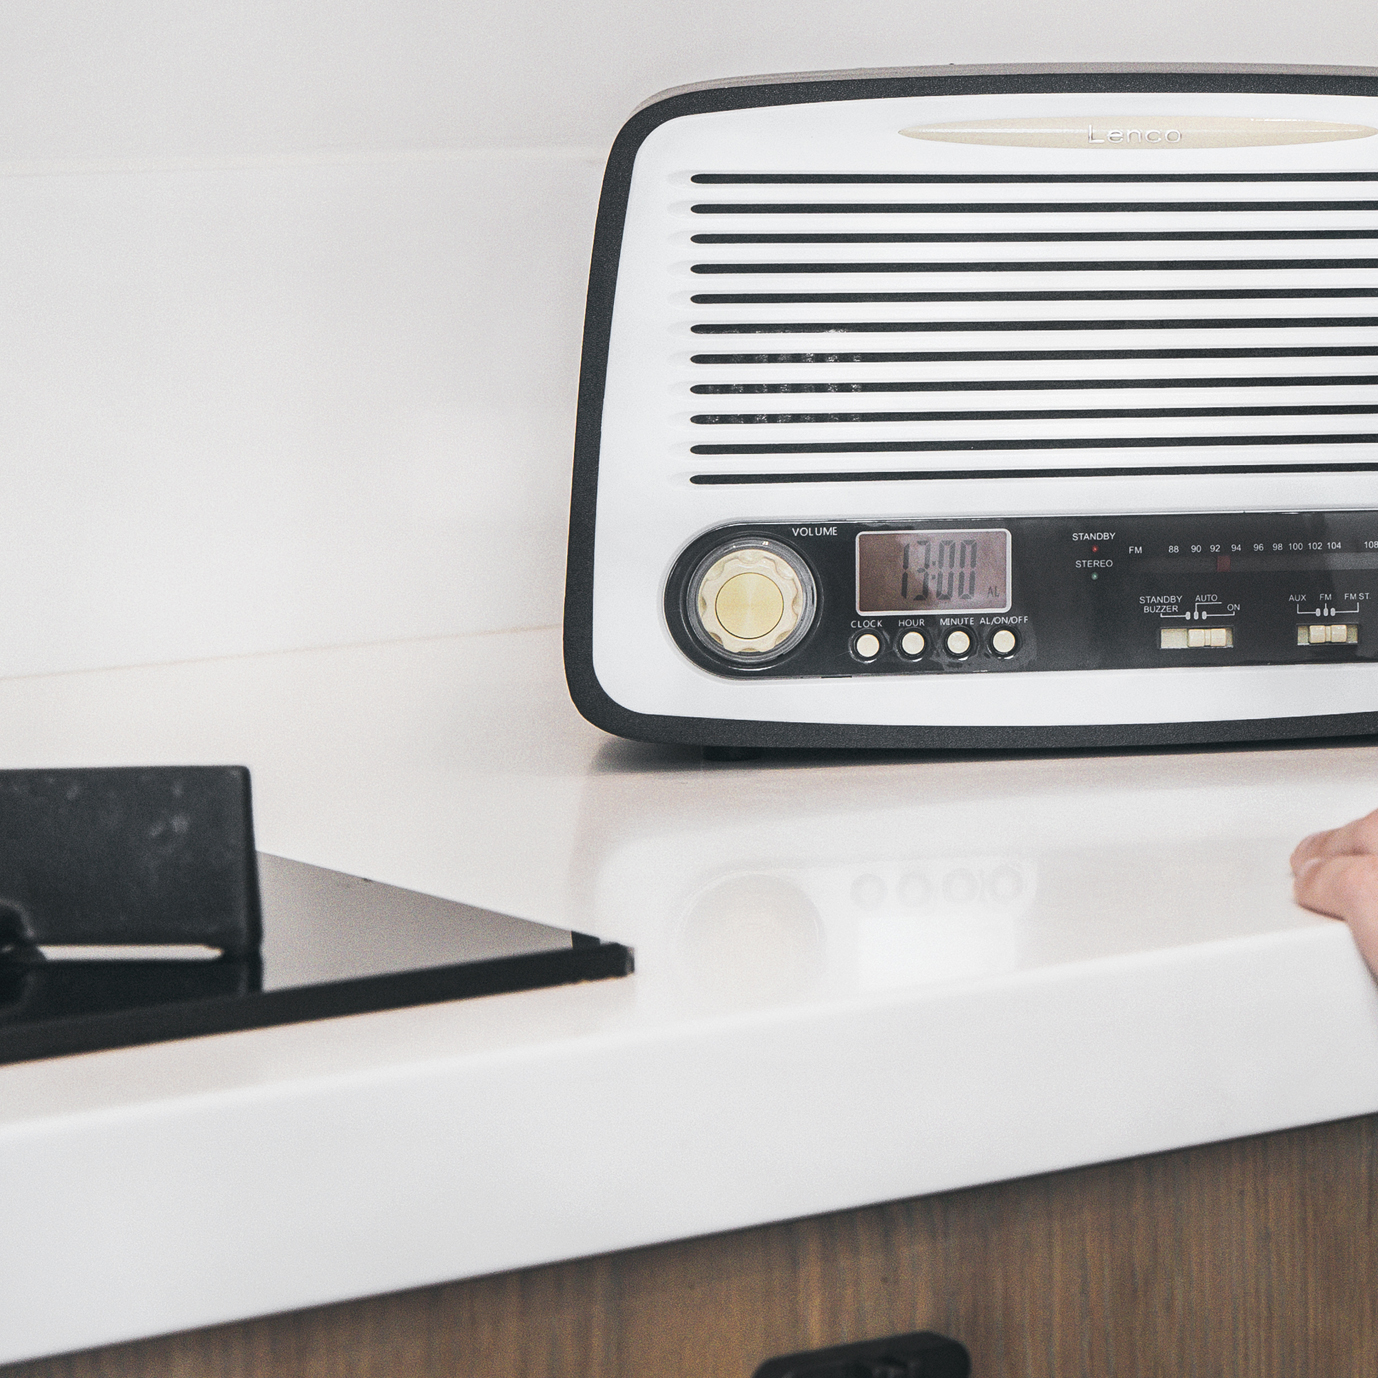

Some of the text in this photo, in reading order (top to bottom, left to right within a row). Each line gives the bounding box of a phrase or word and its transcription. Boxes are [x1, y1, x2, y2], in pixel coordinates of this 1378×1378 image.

[1087, 124, 1182, 144] Lenco
[791, 527, 838, 537] VOLUME
[1072, 532, 1116, 541] STANDBY
[1128, 546, 1143, 554] FM
[1168, 545, 1180, 554] 88
[1190, 544, 1202, 553] 90
[1209, 544, 1221, 553] 92
[1231, 543, 1242, 552] 94
[1253, 543, 1264, 552] 96
[1272, 543, 1283, 551] 98
[1288, 542, 1304, 551] 100
[1307, 541, 1323, 550] 102
[1326, 541, 1342, 550] 104
[1364, 540, 1378, 549] 108
[1075, 559, 1114, 568] STEREO
[901, 539, 977, 601] 13:00
[987, 586, 1000, 598] AL
[1344, 592, 1372, 601] FM ST.
[1139, 595, 1183, 604] STANDBY
[1195, 594, 1218, 602] AUTO
[1288, 594, 1307, 602] AUX
[1319, 593, 1332, 601] FM
[1143, 605, 1179, 614] BUZZER
[1227, 603, 1241, 612] ON
[850, 619, 883, 629] CLOCK
[898, 618, 925, 627] HOUR
[939, 616, 975, 626] MINUTE
